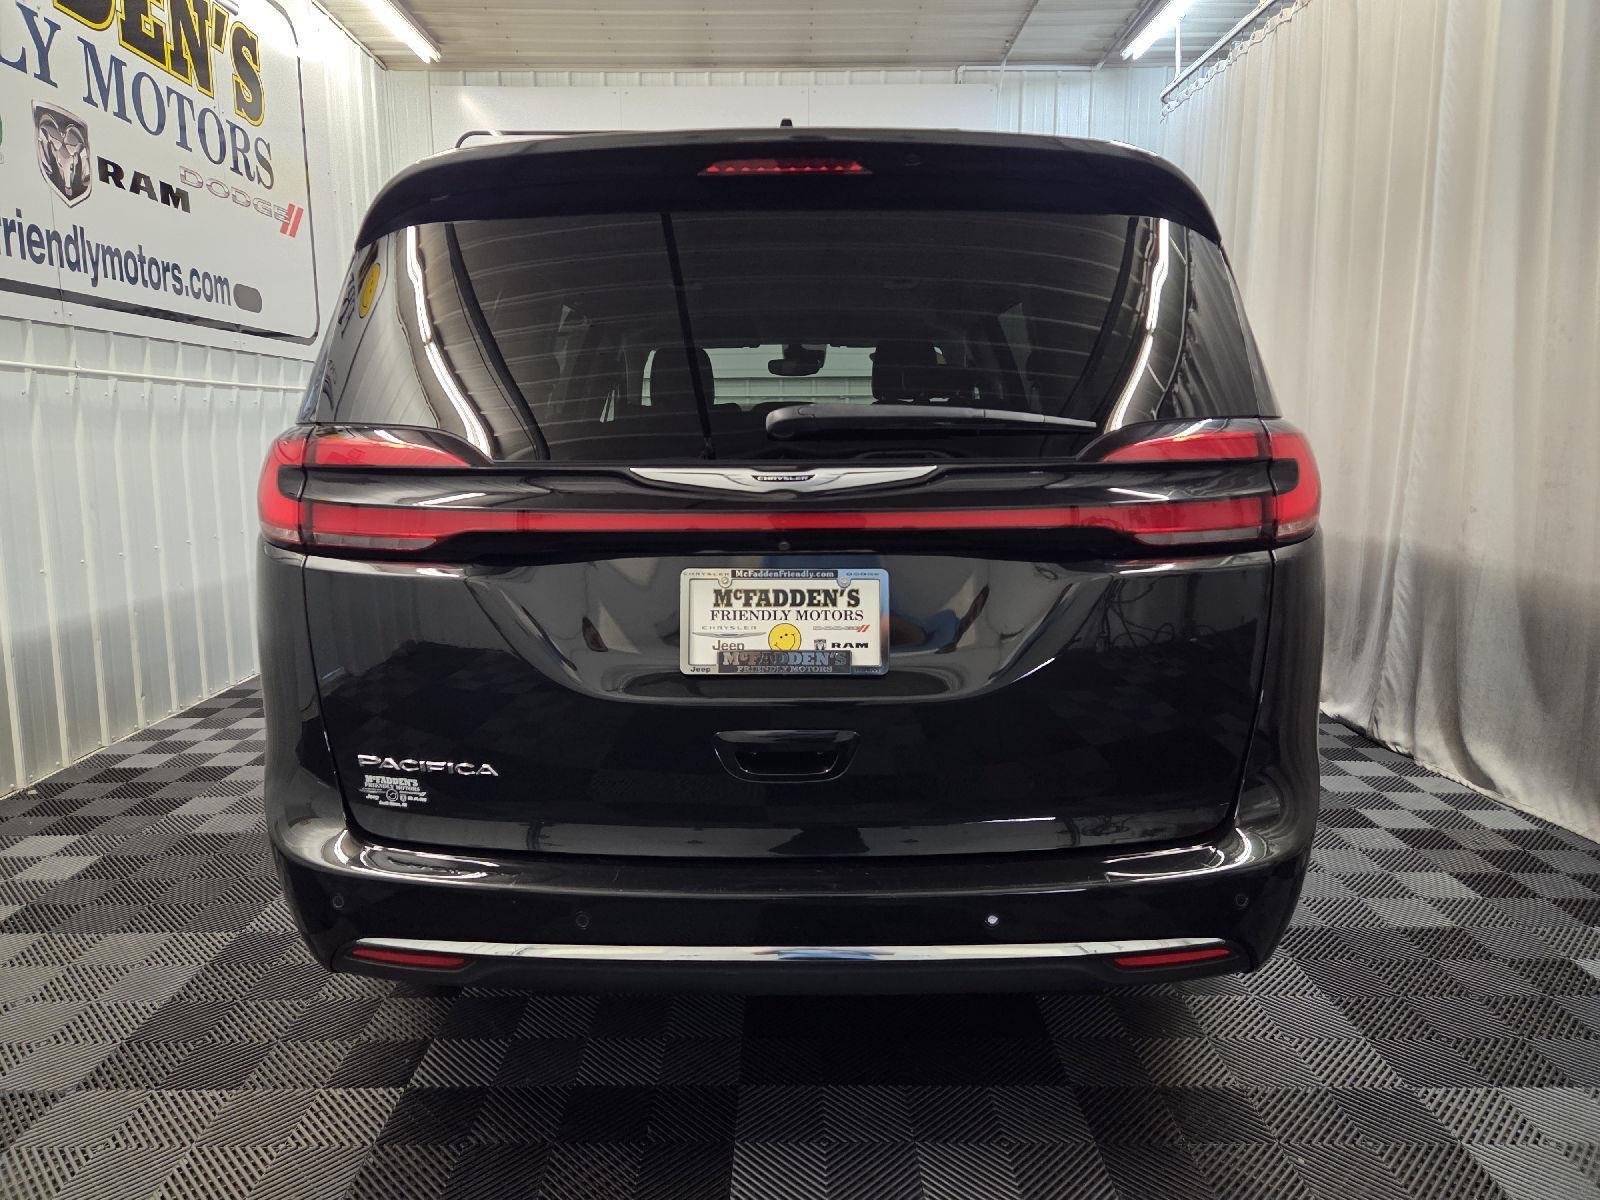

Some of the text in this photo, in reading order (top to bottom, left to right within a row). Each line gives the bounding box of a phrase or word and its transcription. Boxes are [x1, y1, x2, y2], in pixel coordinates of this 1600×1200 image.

[52, 0, 266, 127] EN'S
[77, 36, 274, 190] MOTORS
[97, 156, 190, 213] RAM
[179, 165, 291, 224] DODGE
[0, 207, 232, 306] riendlymotors.com
[735, 569, 835, 579] McFaddenFriendly.com
[710, 610, 864, 621] FRIENDLY MOTORS
[357, 754, 499, 777] PACIFICA
